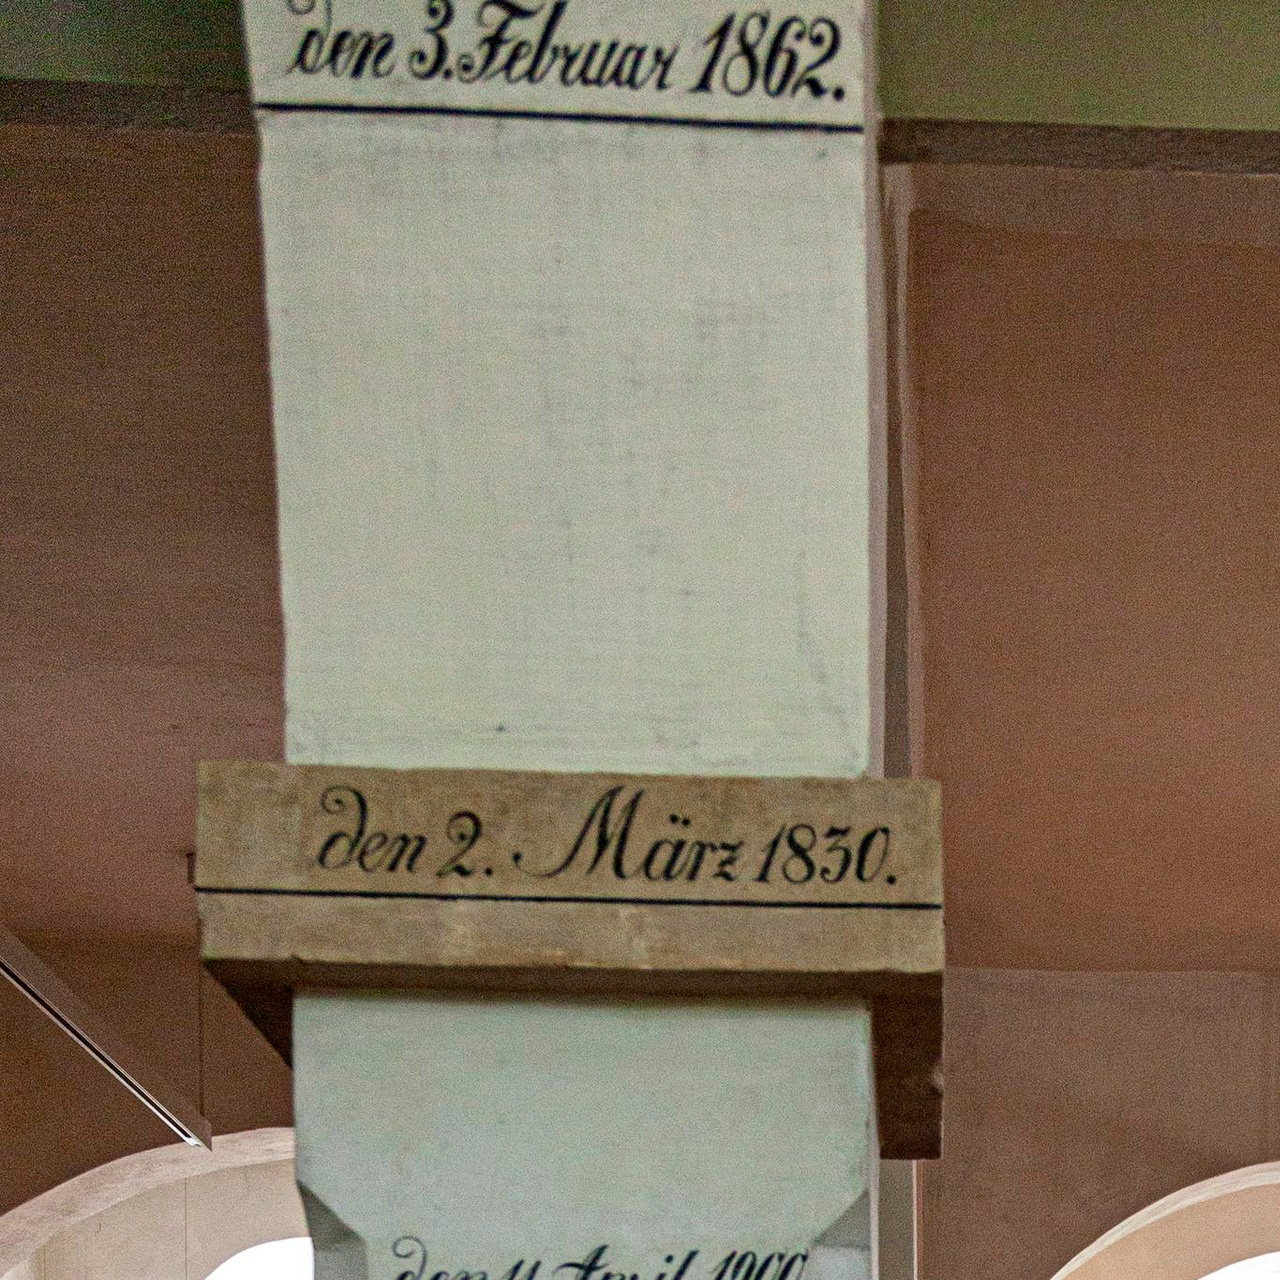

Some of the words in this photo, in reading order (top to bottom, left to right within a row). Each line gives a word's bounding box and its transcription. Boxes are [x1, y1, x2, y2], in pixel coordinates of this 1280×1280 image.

[284, 0, 396, 81] den
[407, 0, 456, 81] 3.
[454, 0, 676, 91] Februar
[689, 11, 848, 104] 1862.
[318, 786, 428, 874] den
[436, 811, 495, 880] 2.
[511, 786, 745, 884] März
[755, 824, 899, 887] 1830.
